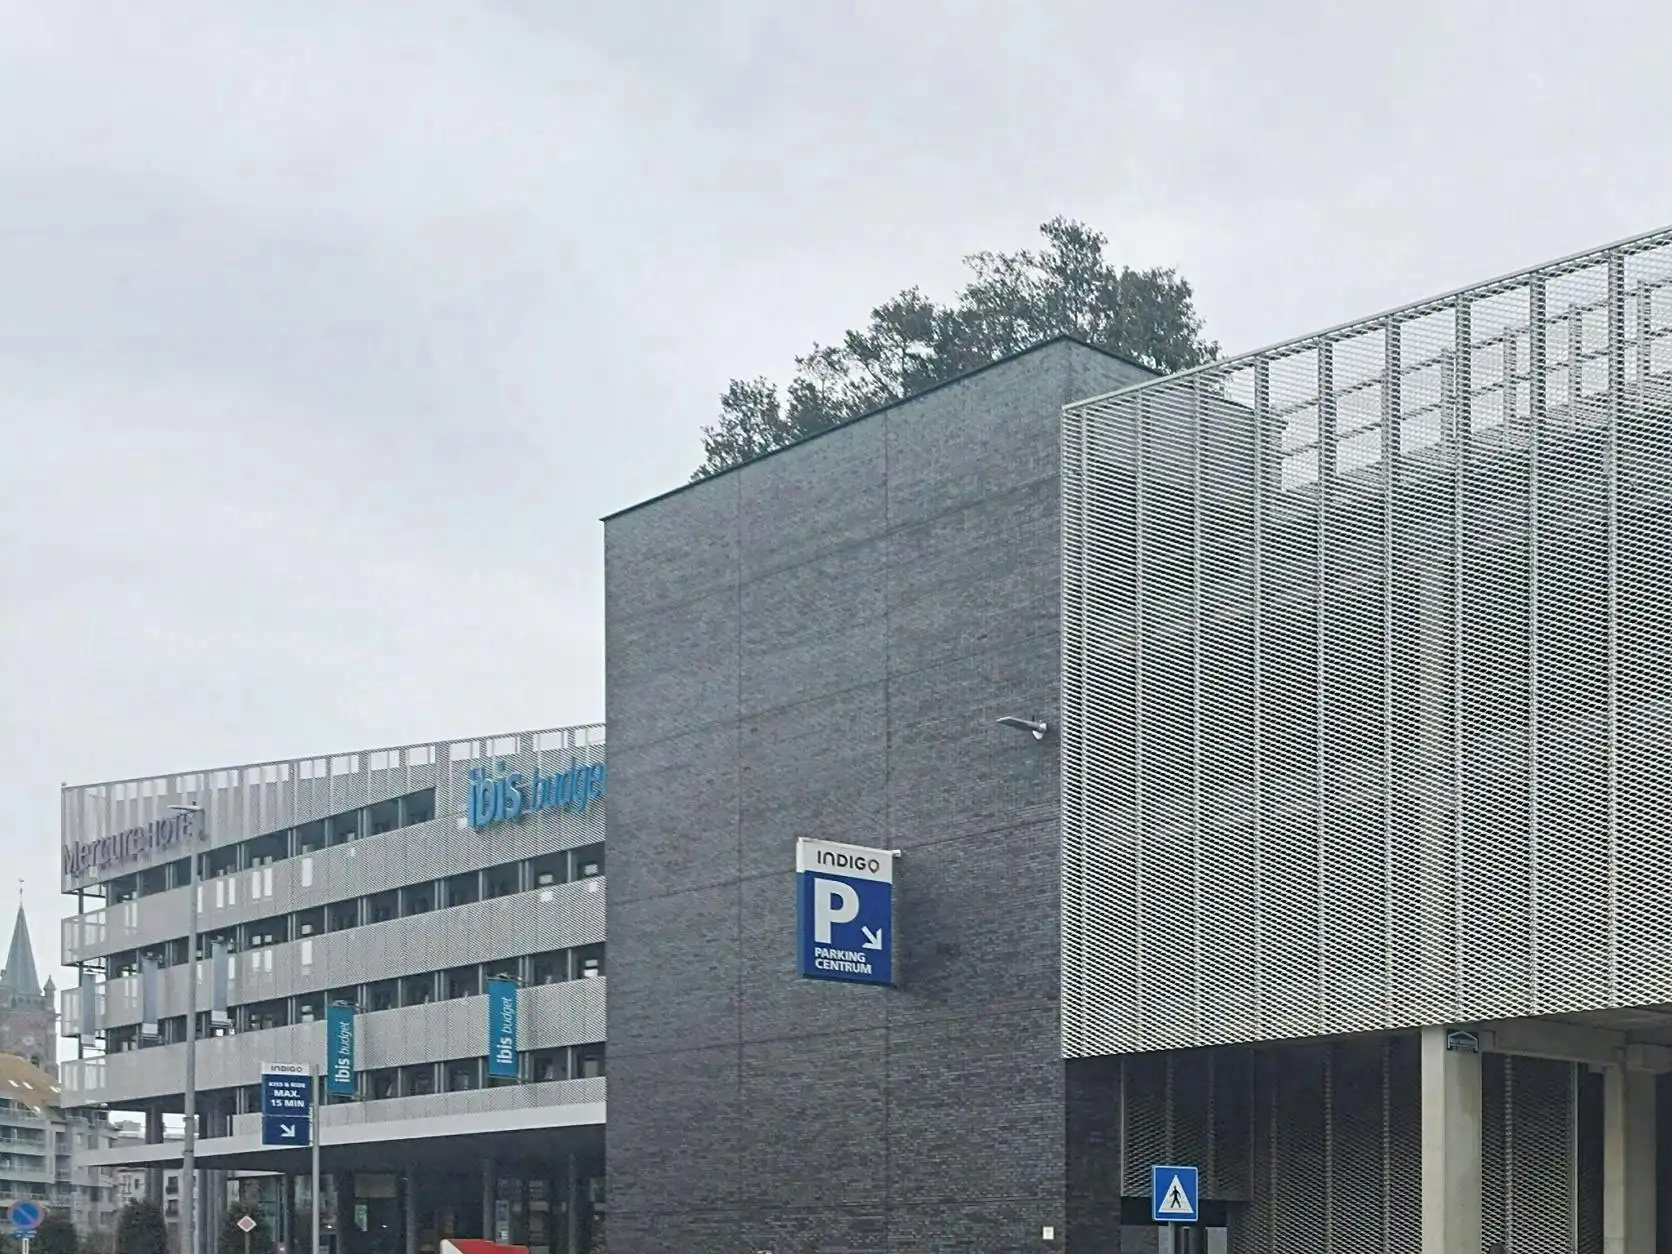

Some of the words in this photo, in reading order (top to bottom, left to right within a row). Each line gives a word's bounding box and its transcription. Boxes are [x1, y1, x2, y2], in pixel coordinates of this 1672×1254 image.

[467, 759, 522, 831] ibis
[63, 826, 146, 877] Mercure
[817, 850, 880, 873] INDIGO
[814, 877, 860, 944] P
[814, 947, 866, 963] PARKING
[814, 958, 872, 974] CENTRUM
[501, 997, 514, 1034] budget
[338, 1022, 352, 1055] budget
[496, 1037, 512, 1064] ibis
[271, 1065, 303, 1073] INDIGO
[335, 1059, 350, 1082] ibis
[273, 1089, 301, 1098] MAX.
[284, 1099, 305, 1108] MIN
